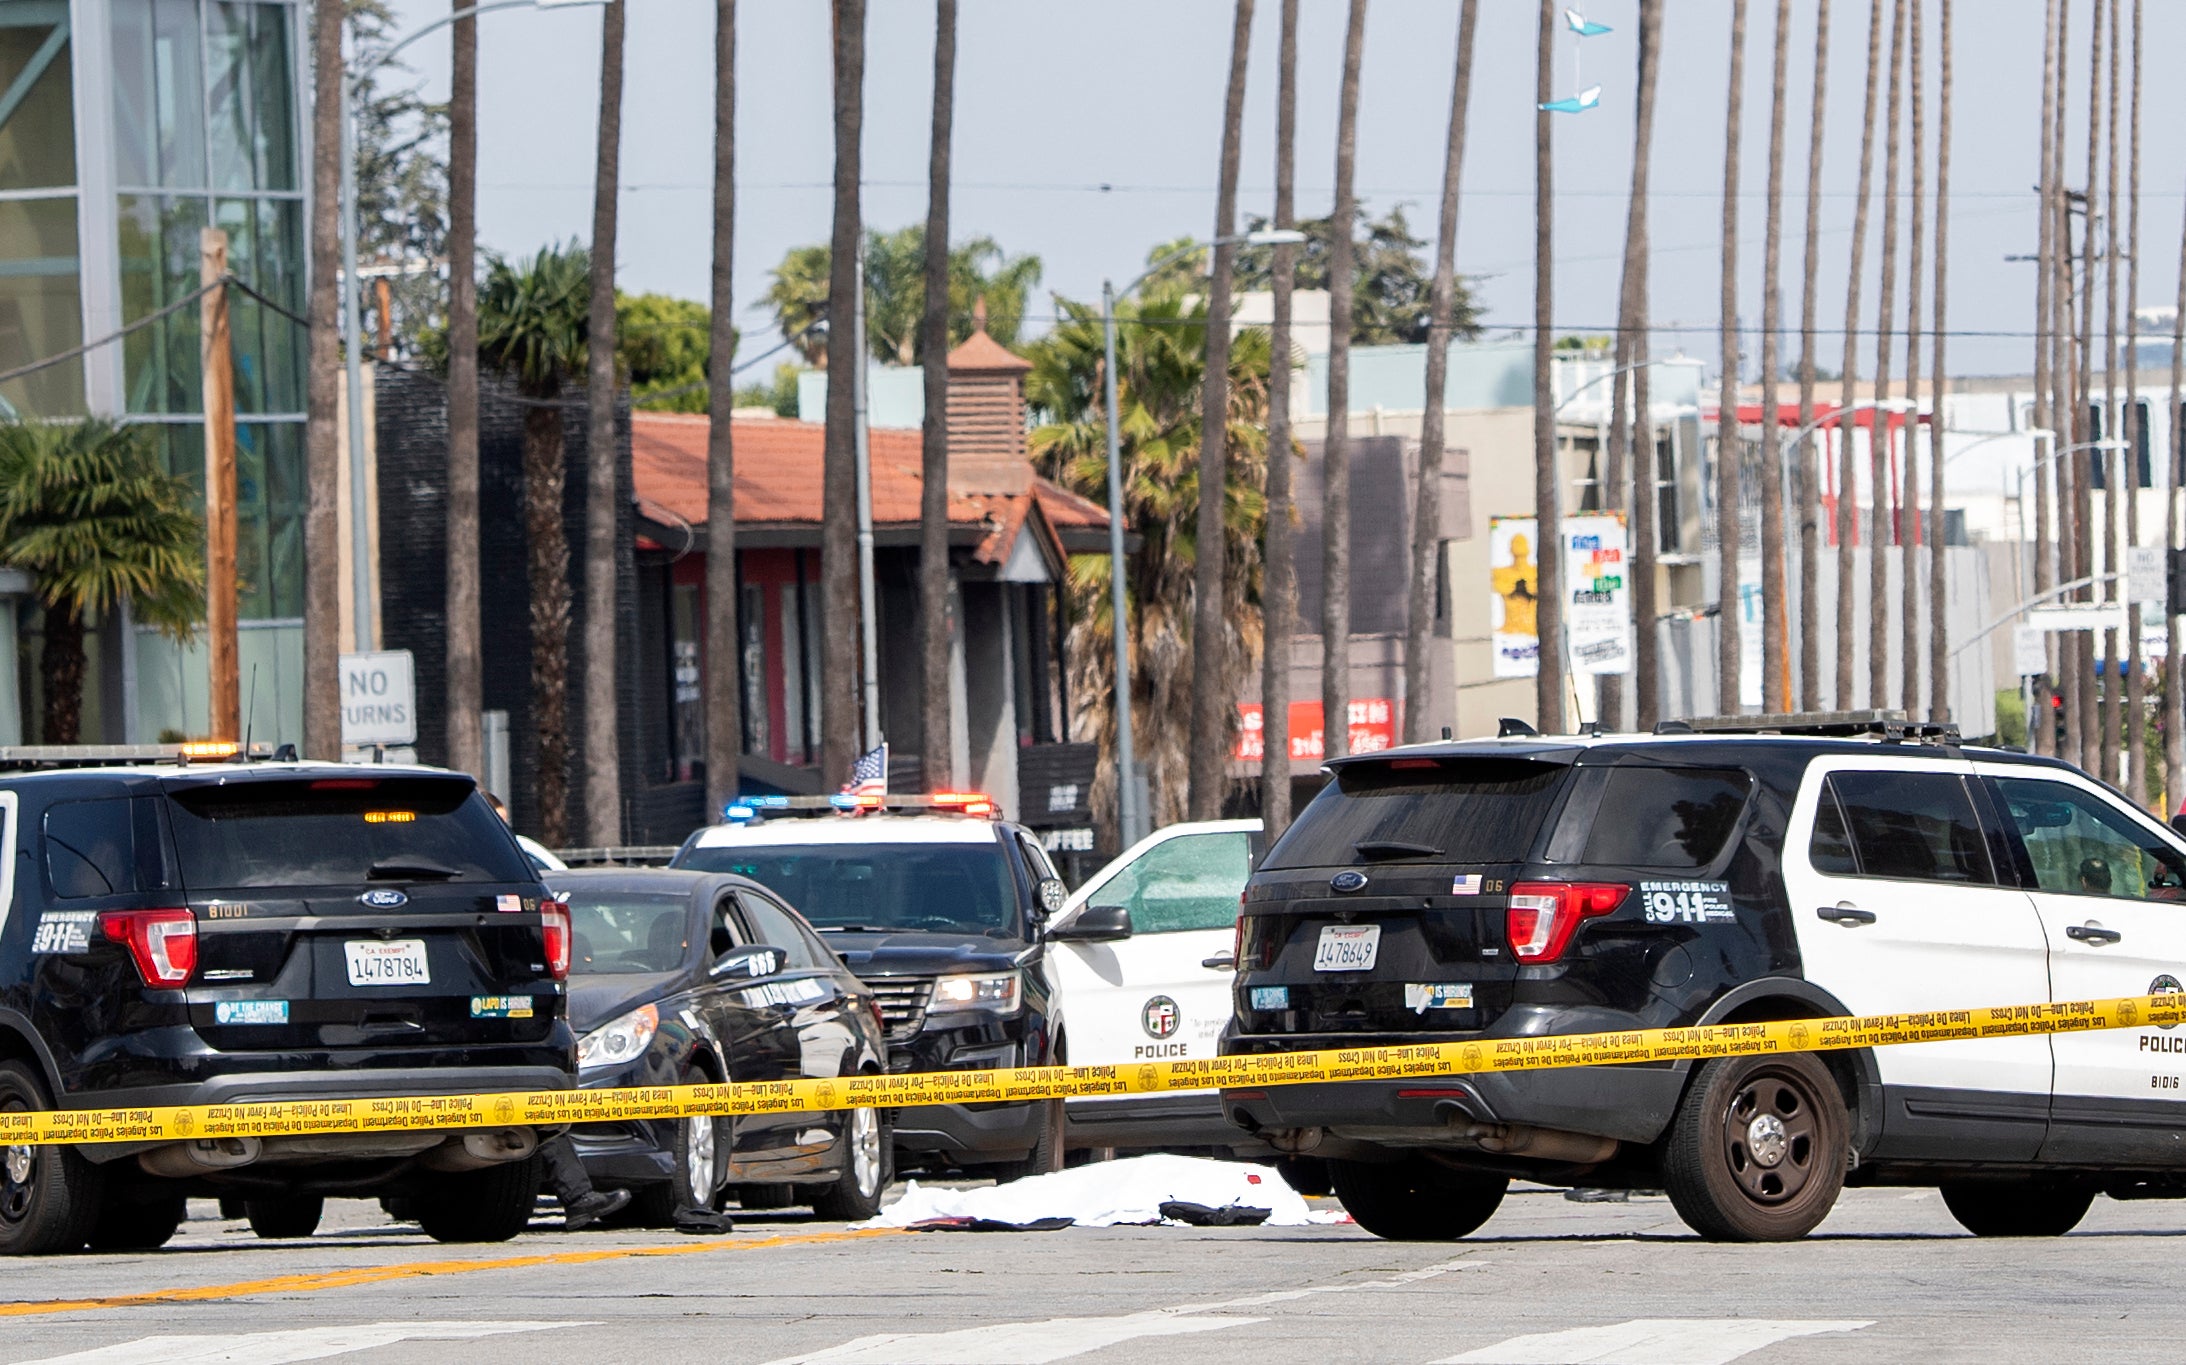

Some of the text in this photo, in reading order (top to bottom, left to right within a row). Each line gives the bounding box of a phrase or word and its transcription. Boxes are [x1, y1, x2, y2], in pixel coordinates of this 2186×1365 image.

[350, 669, 387, 697] NO
[1041, 829, 1093, 851] OFFEE
[1486, 880, 1503, 892] 06
[1640, 881, 1728, 892] EMERGENCY
[523, 898, 536, 911] 06
[1643, 892, 1655, 922] CALL
[1653, 892, 1707, 923] 9-1-1
[40, 911, 97, 922] EMERGENCY
[208, 904, 248, 919] 81001
[1319, 942, 1372, 963] 1478649
[355, 957, 423, 978] 1478784
[748, 951, 776, 977] 666
[1991, 1008, 2012, 1020] Cross
[2014, 1007, 2028, 1019] Not
[2069, 1002, 2094, 1015] Police
[1863, 1017, 1883, 1030] Favor
[1936, 1012, 1947, 1025] De
[2147, 1011, 2179, 1024] Angeles
[1741, 1025, 1765, 1038] Police
[1822, 1020, 1847, 1032] Cruzar
[1849, 1019, 1861, 1031] No
[1981, 1016, 2105, 1036] Los Angeles Police Department
[1663, 1030, 1684, 1043] Cross
[1687, 1029, 1700, 1042] Not
[1819, 1035, 1851, 1046] Angeles
[1852, 1034, 1866, 1044] Los
[1868, 1032, 1879, 1044] De
[1908, 1030, 1919, 1042] De
[1920, 1027, 1977, 1041] Departamento
[1135, 1043, 1187, 1058] POLICE
[1653, 1040, 1777, 1057] Los Angeles Police Department
[2140, 1036, 2186, 1053] POLIC
[1338, 1051, 1359, 1064] Cross
[1362, 1050, 1375, 1063] Not
[1415, 1046, 1439, 1059] Police
[1171, 1061, 1196, 1074] Cruzar
[1198, 1060, 1209, 1073] No
[1211, 1059, 1231, 1072] Favor
[1284, 1055, 1294, 1068] De
[1038, 1069, 1051, 1082] Not
[1091, 1065, 1115, 1079] Police
[1268, 1070, 1324, 1081] Departamento
[1328, 1061, 1451, 1078] Los Angeles Police Department
[961, 1074, 971, 1087] De
[1014, 1070, 1035, 1083] Cross
[1168, 1076, 1199, 1089] Angeles
[1200, 1076, 1214, 1088] Los
[1215, 1075, 1226, 1085] De
[1256, 1072, 1267, 1083] De
[2151, 1075, 2180, 1089] 81016
[769, 1083, 793, 1096] Police
[849, 1079, 873, 1091] Cruzar
[875, 1078, 886, 1091] No
[888, 1077, 908, 1090] Favor
[1005, 1080, 1126, 1097] Los Angeles Police Department
[639, 1090, 649, 1102] De
[692, 1087, 714, 1099] Cross
[716, 1086, 729, 1098] Not
[878, 1094, 891, 1103] Los
[892, 1093, 903, 1103] De
[933, 1091, 944, 1101] De
[945, 1088, 1000, 1099] Departamento
[448, 1097, 472, 1110] Police
[528, 1094, 552, 1107] Cruzar
[554, 1094, 565, 1106] No
[567, 1093, 587, 1105] Favor
[683, 1098, 804, 1113] Los Angeles Police Department
[845, 1094, 876, 1106] Angeles
[234, 1107, 244, 1119] No
[247, 1106, 266, 1118] Favor
[319, 1104, 329, 1116] De
[372, 1101, 393, 1113] Cross
[395, 1100, 408, 1113] Not
[611, 1106, 622, 1117] De
[623, 1105, 679, 1115] Departamento
[52, 1113, 73, 1126] Cross
[76, 1113, 89, 1125] Not
[129, 1110, 152, 1123] Police
[207, 1107, 232, 1120] Cruzar
[362, 1112, 482, 1127] Los Angeles Police Department
[524, 1109, 555, 1120] Angeles
[556, 1109, 570, 1119] Los
[571, 1108, 582, 1119] De
[203, 1122, 234, 1133] Angeles
[236, 1122, 249, 1132] Los
[251, 1121, 261, 1132] De
[291, 1120, 301, 1131] De
[303, 1118, 358, 1129] Departamento
[42, 1125, 162, 1140] Los Angeles Police Department
